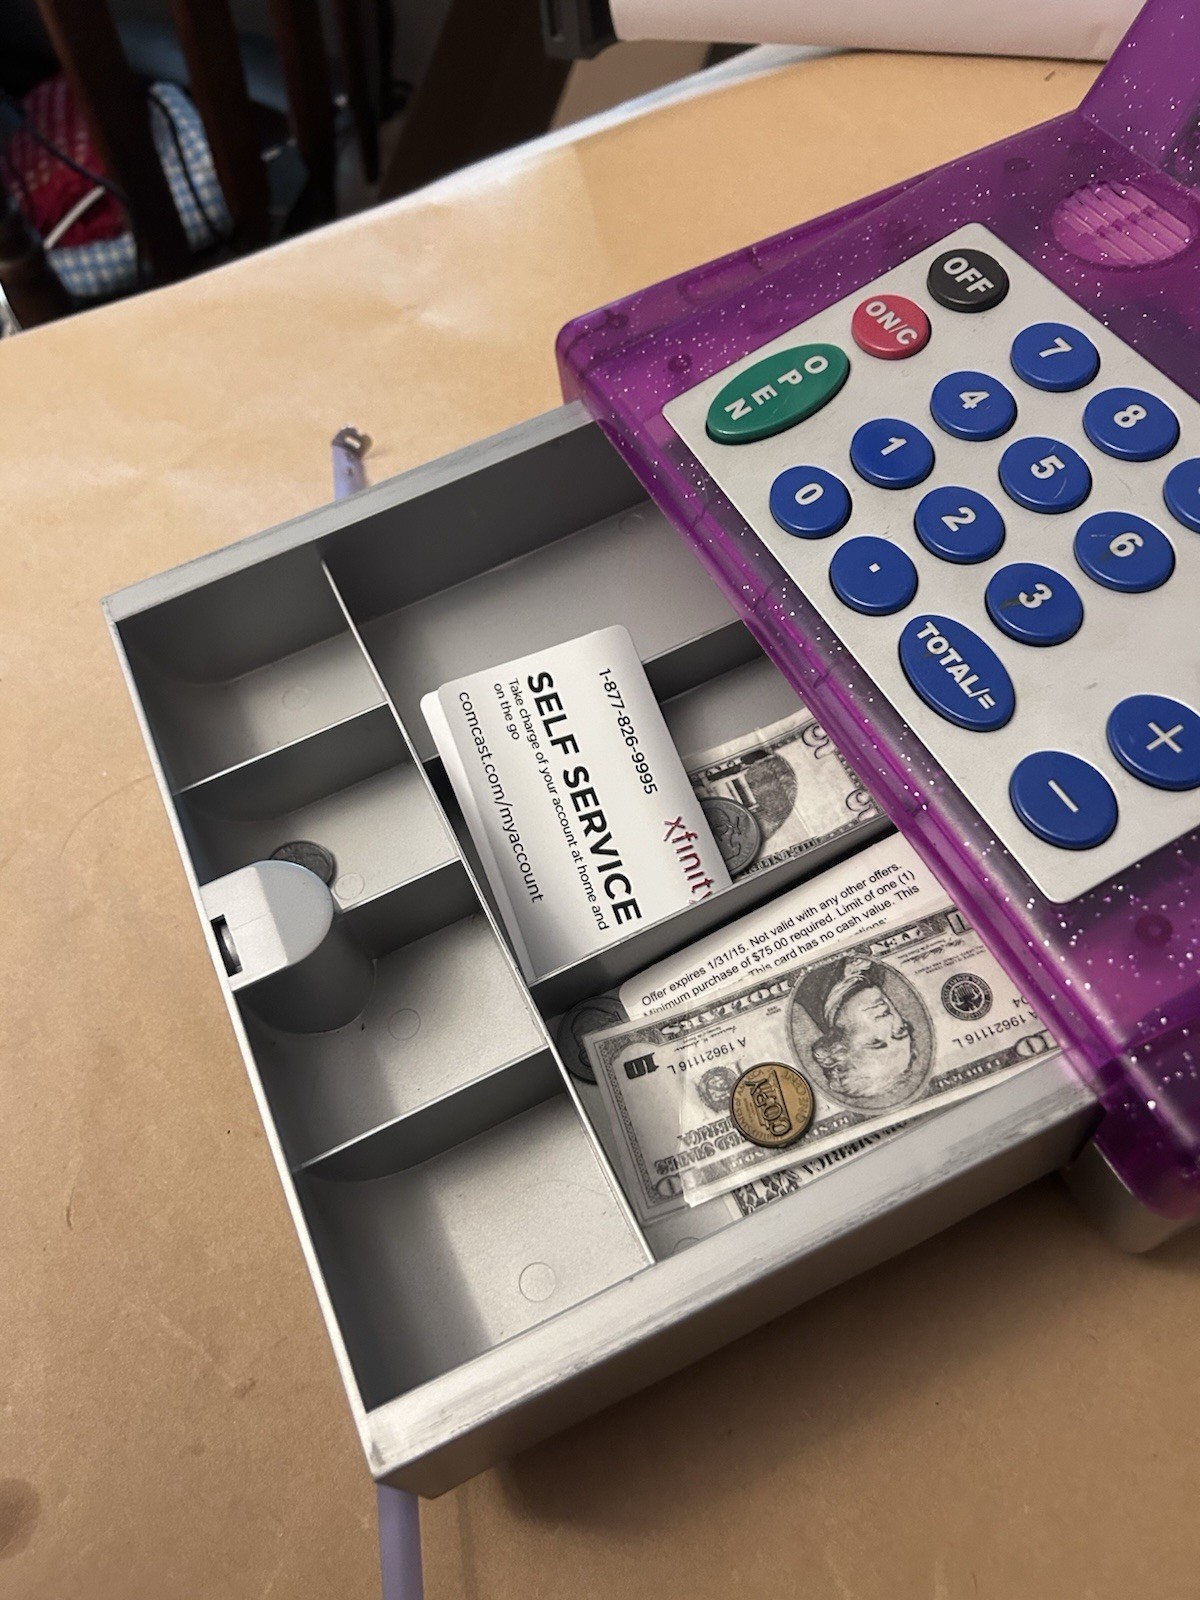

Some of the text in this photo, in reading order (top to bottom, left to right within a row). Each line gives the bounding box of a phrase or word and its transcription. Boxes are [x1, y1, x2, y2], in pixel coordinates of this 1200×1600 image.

[943, 256, 994, 294] OFF
[865, 300, 918, 345] ON/C
[1038, 336, 1073, 358] 7
[724, 355, 829, 421] OPEN
[959, 390, 990, 410] 4
[1113, 404, 1147, 428] 8
[880, 436, 907, 456] 1
[1030, 454, 1066, 479] 5
[794, 483, 824, 505] 0
[941, 506, 976, 532] 2
[1109, 532, 1144, 558] 6
[1018, 582, 1053, 609] 3
[916, 621, 996, 710] TOTAL/=
[493, 683, 520, 740] on the go
[599, 667, 658, 795] 1-877-826-9995
[459, 691, 544, 903] comcast.com/myaccount
[509, 677, 609, 930] Take charge of your account at home and
[527, 671, 643, 925] SELF SERVICE
[642, 863, 902, 1006] Offer expires 1/31/15. Not valid with any other offers.
[692, 965, 739, 997] purchase
[741, 957, 752, 969] of
[752, 937, 788, 962] $75.00
[790, 913, 836, 943] required.
[836, 899, 864, 917] Limit
[864, 889, 878, 902] of
[877, 880, 897, 895] one
[898, 870, 916, 885] (1)
[748, 885, 920, 977] This card has no cash value. This
[952, 1038, 963, 1048] L
[965, 1014, 1027, 1044] 19621116
[667, 1037, 747, 1075] A 19621116 L
[744, 1076, 792, 1137] COPY
[677, 1116, 736, 1149] ERICA
[653, 1141, 717, 1176] STATES
